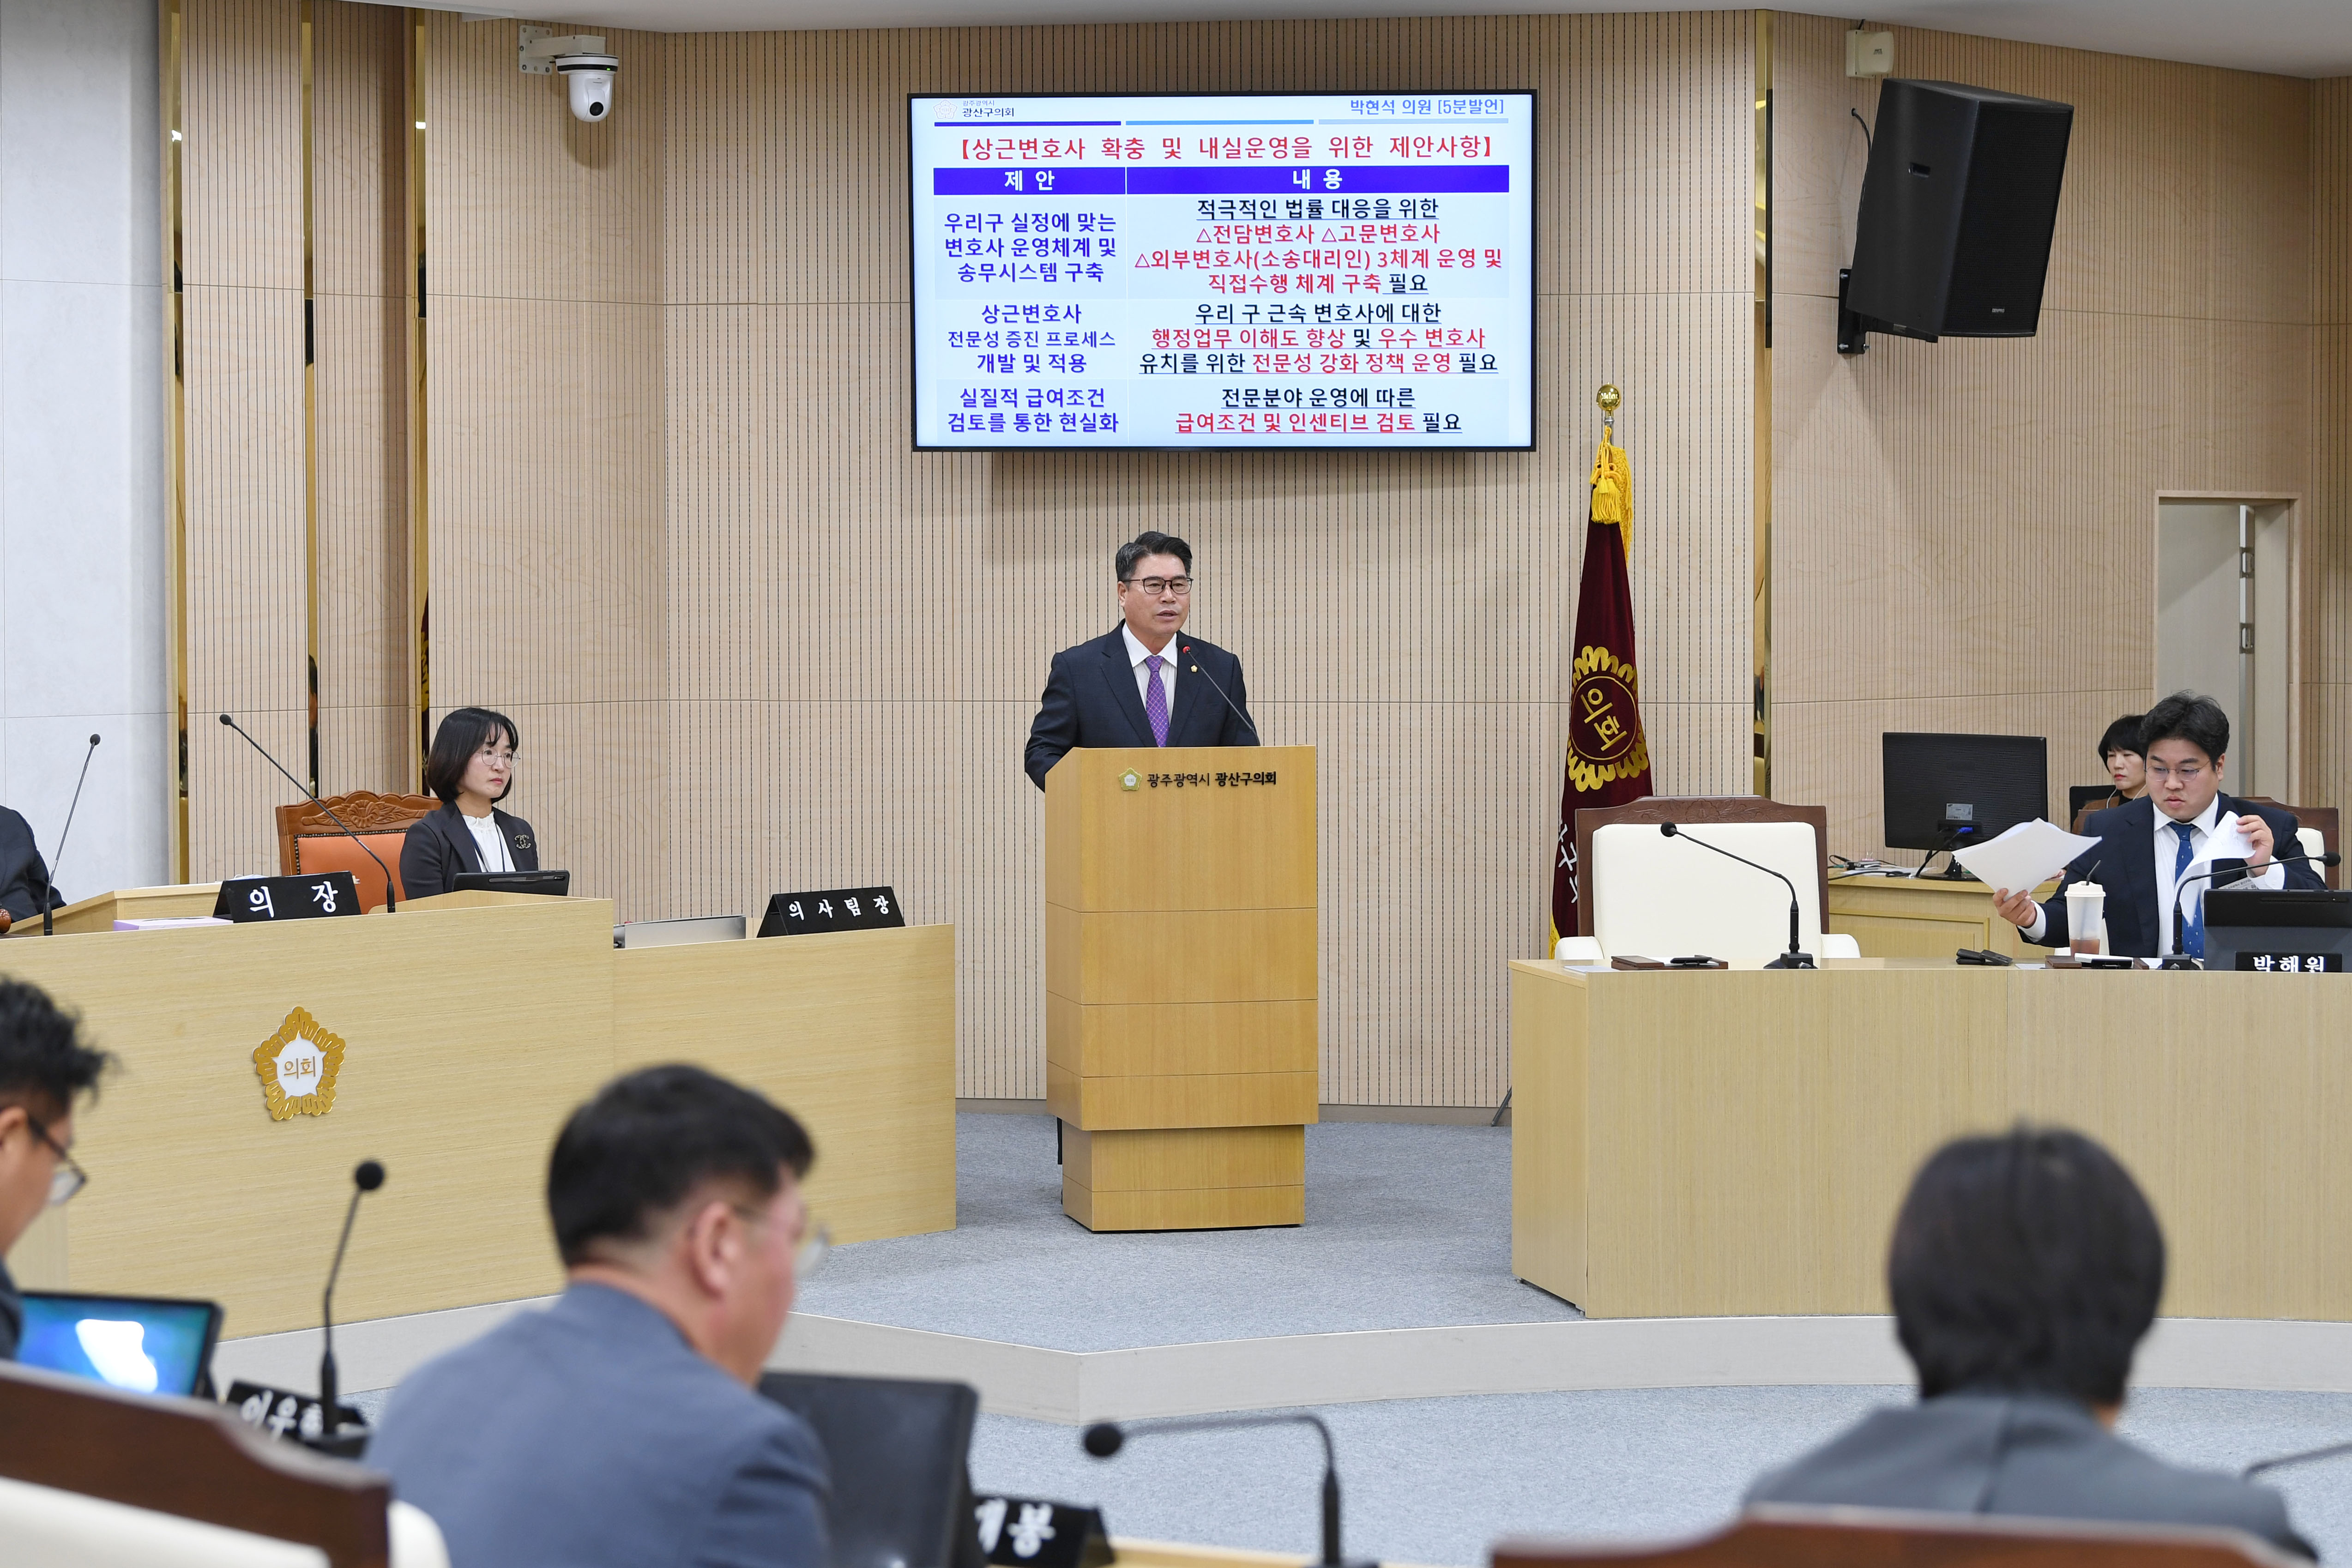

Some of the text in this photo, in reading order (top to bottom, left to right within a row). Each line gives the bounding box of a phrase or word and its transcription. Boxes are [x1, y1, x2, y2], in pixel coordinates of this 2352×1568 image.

[962, 107, 1014, 117] 광산구의회
[1351, 99, 1504, 115] 박현석 의원 [5분발언]
[1102, 138, 1145, 159] 확충
[1163, 138, 1181, 159] 및
[1200, 138, 1312, 158] 내실운영을
[1329, 136, 1373, 158] 위한
[1198, 199, 1439, 219] 적극적인 법률 대응을 위한
[944, 212, 1116, 233] 우리구 실정에 맞는
[946, 238, 1116, 258] 변호사 운영체계 및
[1378, 249, 1429, 269] 3체계
[1437, 248, 1475, 268] 운영
[1485, 249, 1502, 268] 및
[958, 263, 1104, 282] 송무시스템 구축
[1209, 273, 1428, 293] 직접수행 체계 구축 필요
[982, 304, 1081, 324] 상근변호사
[1196, 303, 1441, 323] 우리 구 근속 변호사에 대한
[948, 331, 1115, 348] 전문성 증진 프로세스
[1152, 328, 1485, 348] 행정업무 이해도 향상 및 우수 변호사
[977, 354, 1087, 374] 개발 및 적용
[1140, 353, 1497, 373] 유치를 위한 전문성 강화 정책 운영 필요
[960, 388, 1104, 408] 실질적 급여조건
[1222, 388, 1415, 407] 전문분야 운영에 따른
[948, 412, 1119, 433] 검토를 통한 현실화
[1176, 412, 1461, 432] 급여조건 및 인센티브 검토 필요
[1581, 688, 1627, 751] 의회
[1147, 771, 1277, 787] 광주광역시 광산구의회
[789, 895, 889, 921] 의사팀장
[284, 1055, 316, 1079] 의회
